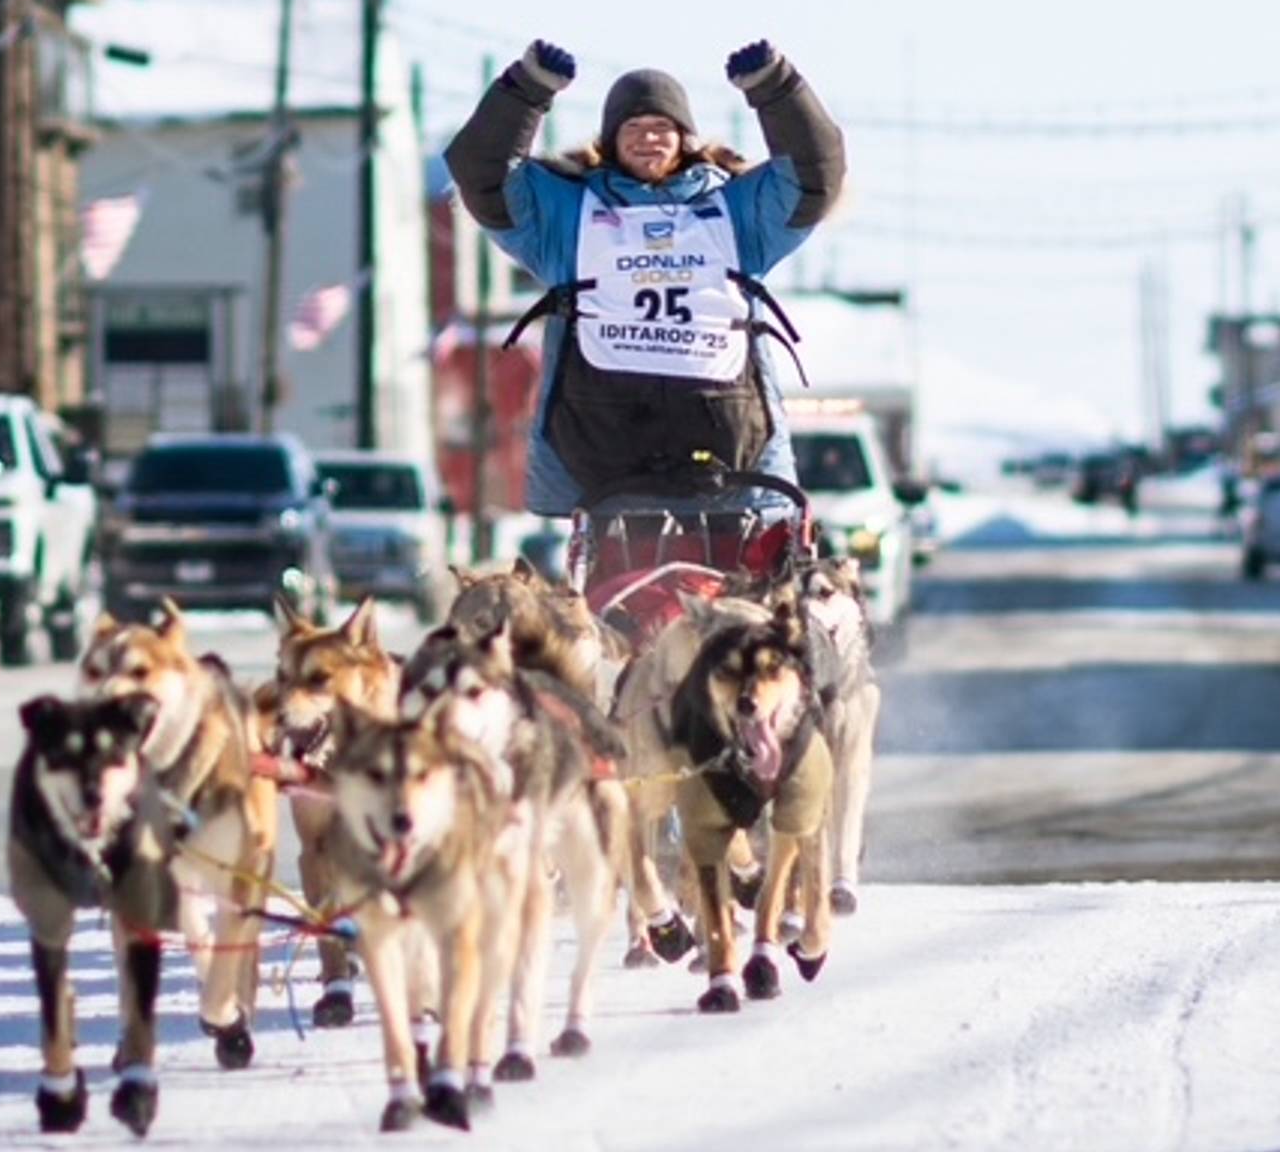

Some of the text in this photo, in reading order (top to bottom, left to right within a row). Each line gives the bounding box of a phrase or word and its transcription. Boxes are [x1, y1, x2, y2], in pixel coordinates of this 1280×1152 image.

[616, 254, 705, 271] DONLIN
[631, 270, 692, 284] GOLD
[633, 286, 693, 325] 25
[600, 324, 695, 344] IDITAROD
